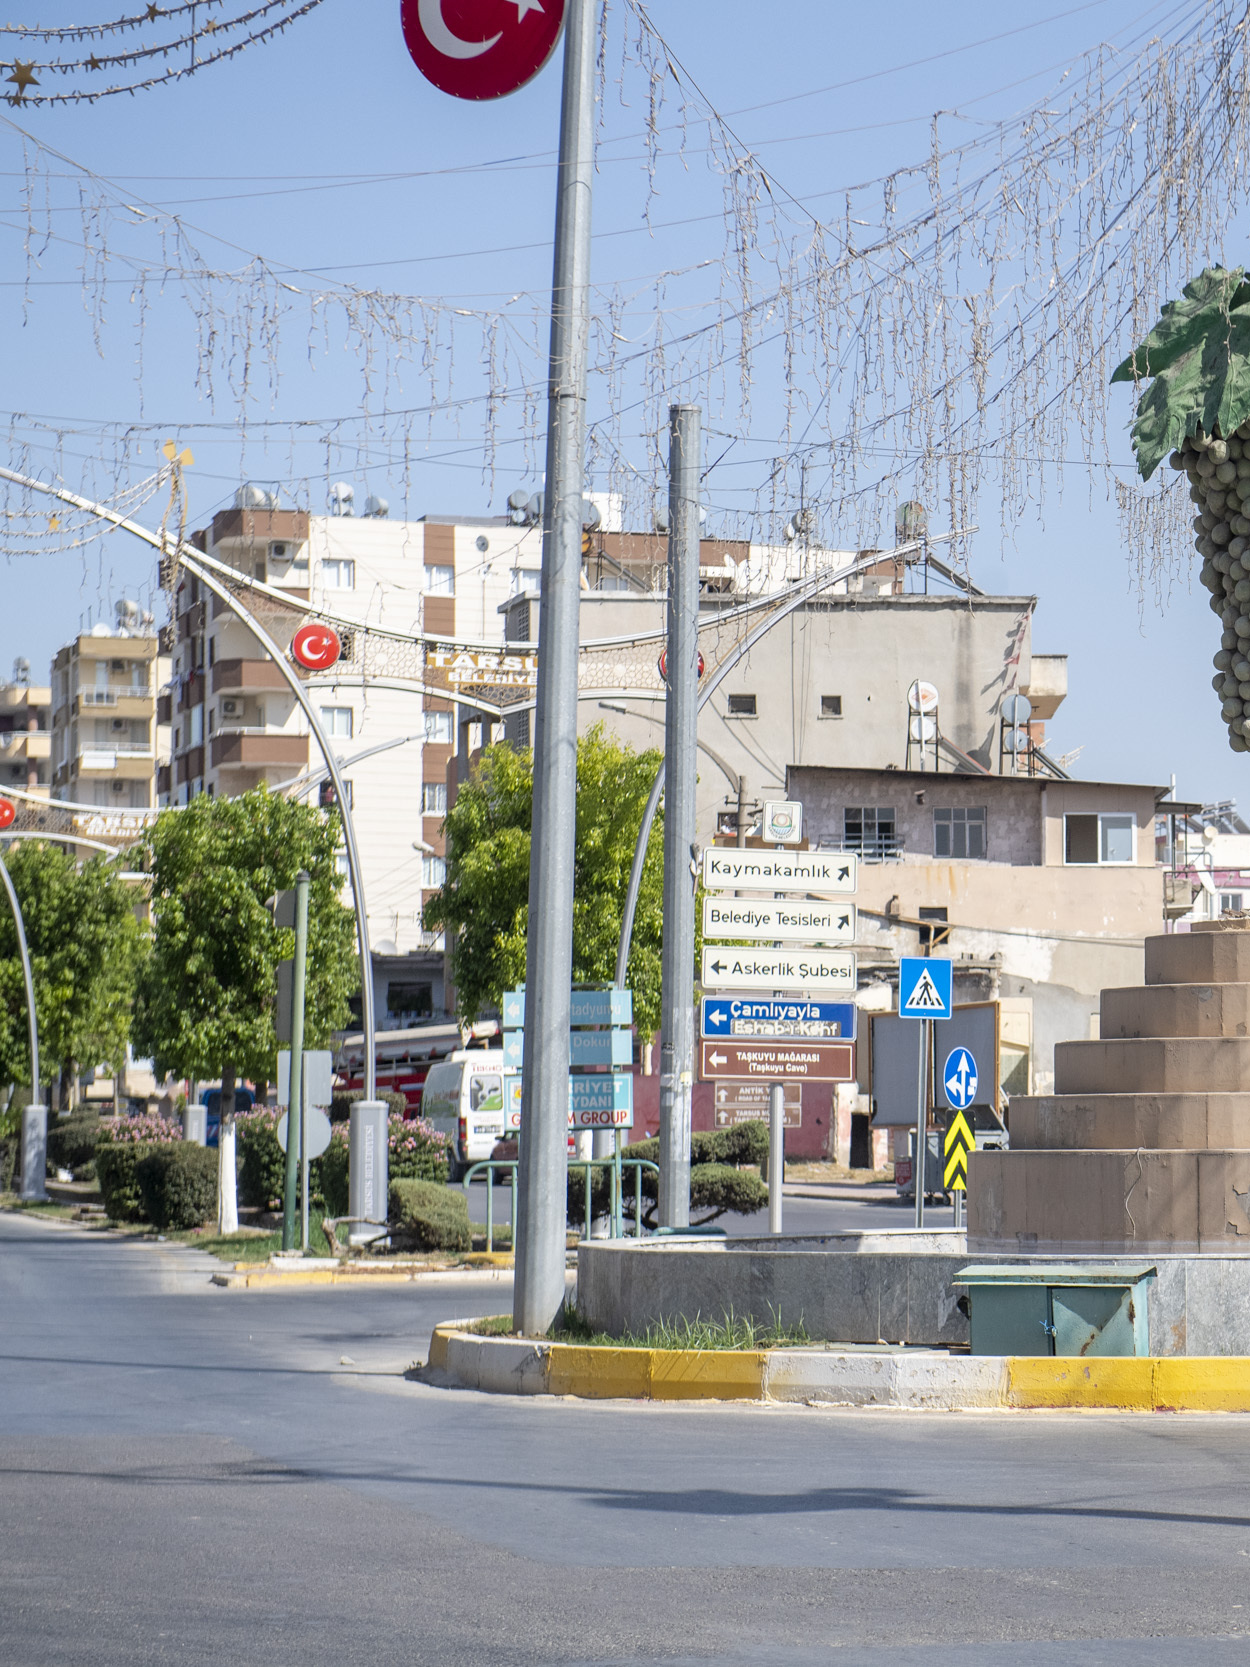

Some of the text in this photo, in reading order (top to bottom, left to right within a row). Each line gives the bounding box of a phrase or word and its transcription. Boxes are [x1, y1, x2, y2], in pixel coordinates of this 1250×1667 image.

[428, 652, 538, 671] TARSU
[711, 860, 831, 878] Kaymakamlık
[711, 909, 831, 927] Belediye Tesisleri
[731, 961, 852, 978] Askerlik Şubesi
[730, 1000, 820, 1020] Çamlıyayla
[736, 1051, 820, 1064] TAŞKUYU MAĞARASI
[748, 1062, 808, 1074] (Taşkuyu Cave)
[739, 1085, 764, 1095] ANTİK
[580, 1110, 628, 1125] GROUP
